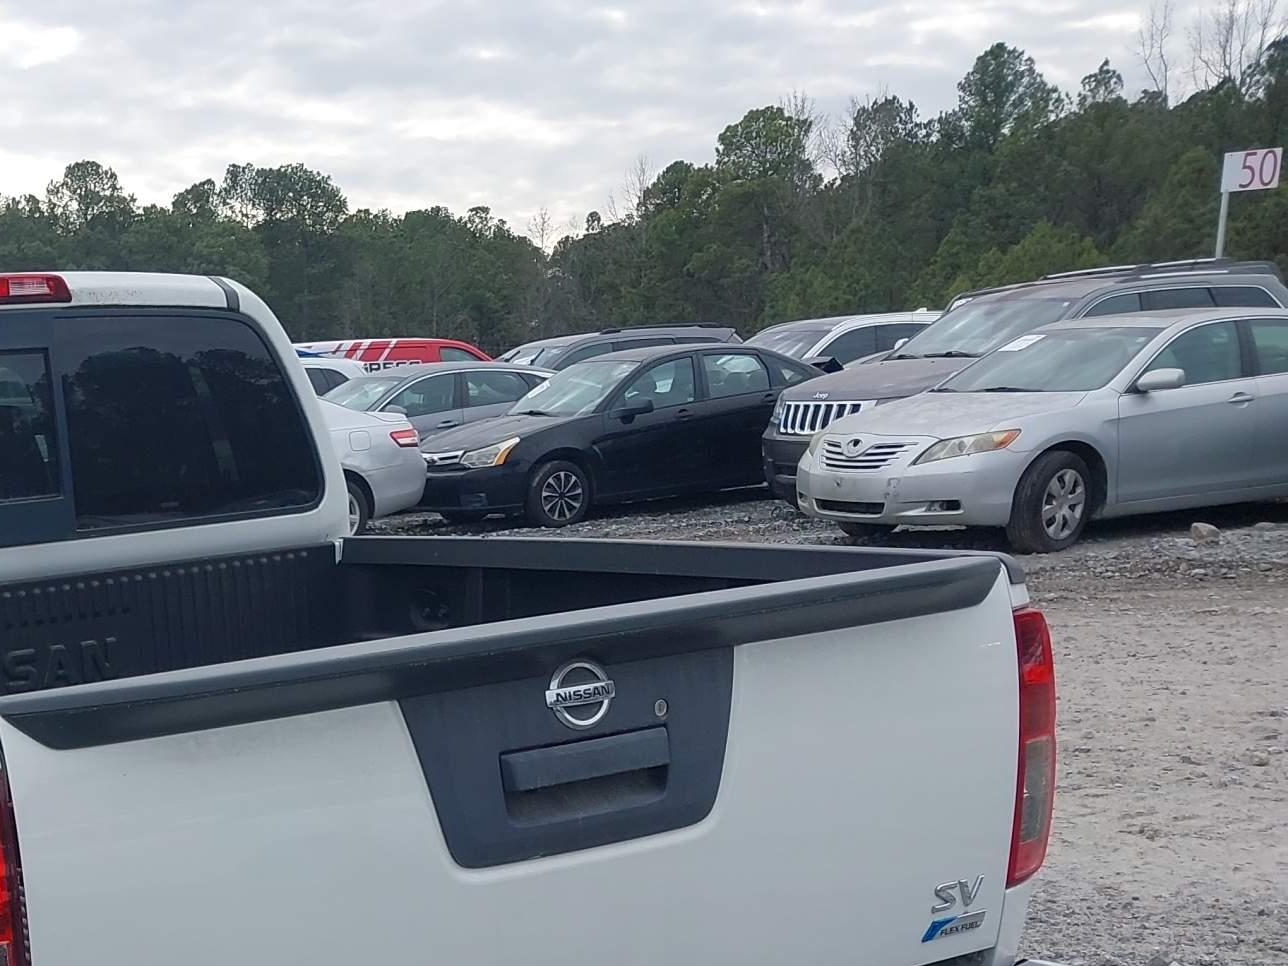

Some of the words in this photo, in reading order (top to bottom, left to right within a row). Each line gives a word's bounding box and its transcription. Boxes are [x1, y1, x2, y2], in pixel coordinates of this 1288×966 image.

[1238, 150, 1278, 189] 50
[555, 685, 611, 702] NISSAN
[931, 874, 985, 914] SV
[940, 925, 959, 936] FLEX
[961, 921, 979, 931] FUEL
